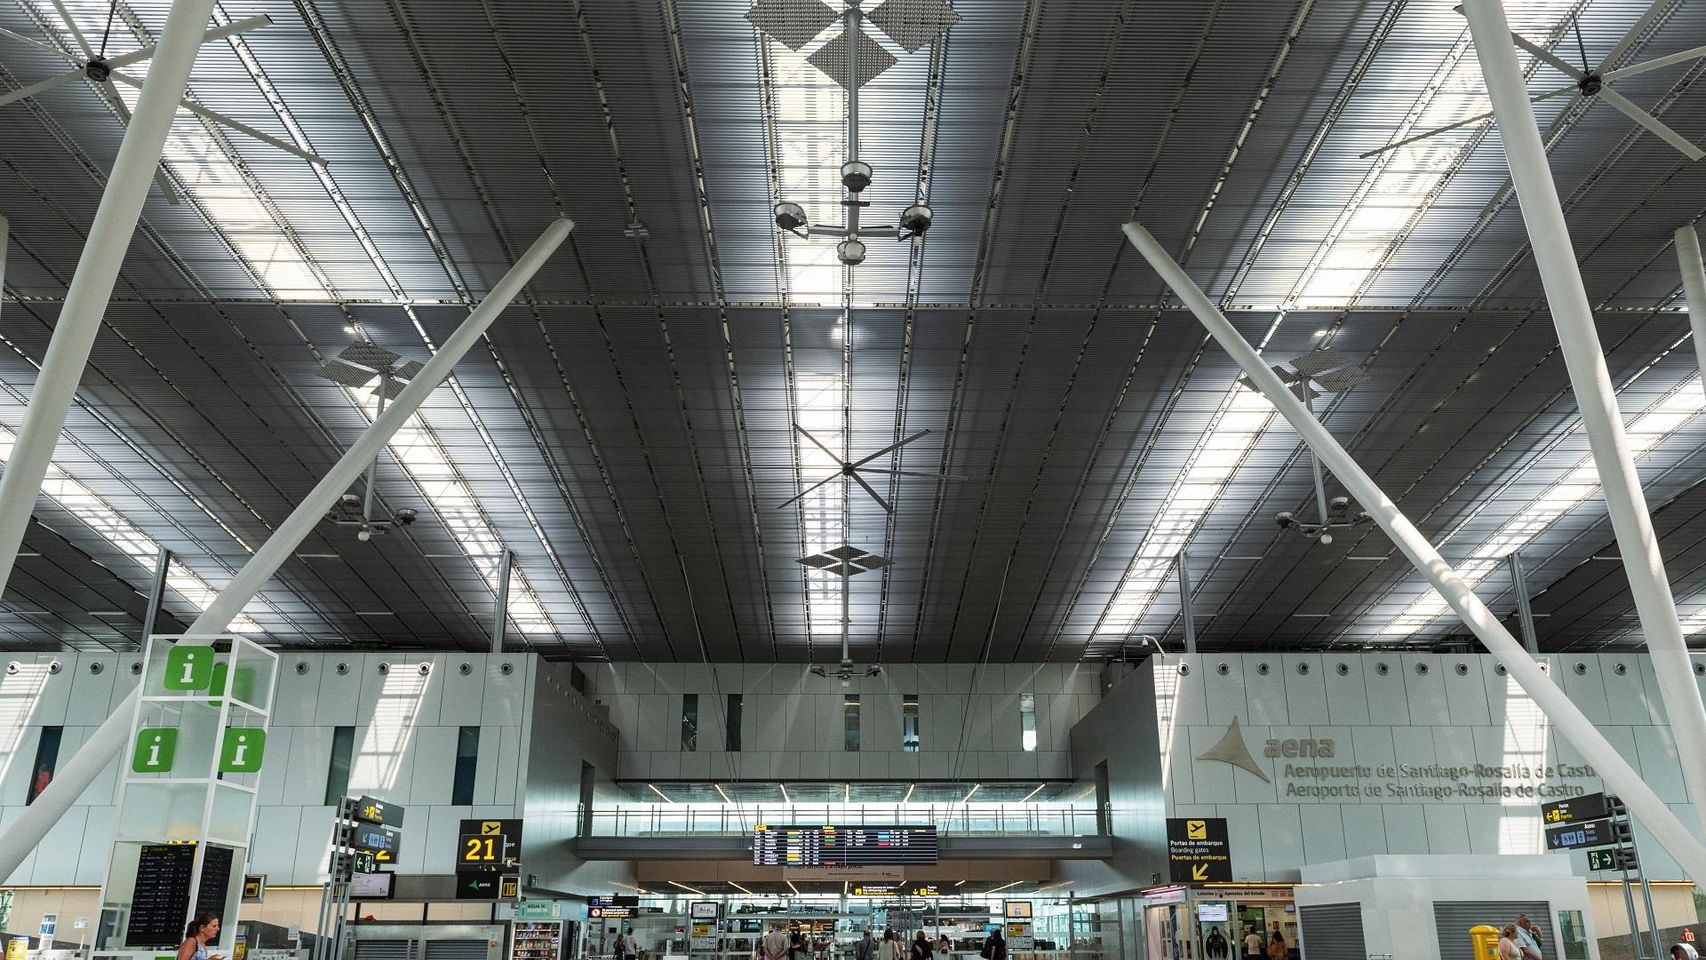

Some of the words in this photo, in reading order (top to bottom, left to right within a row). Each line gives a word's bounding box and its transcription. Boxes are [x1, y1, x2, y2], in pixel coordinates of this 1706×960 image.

[1264, 738, 1335, 758] aena
[1284, 764, 1371, 781] Aeropuerto
[1377, 763, 1396, 777] de
[1535, 764, 1554, 778] de
[1558, 764, 1596, 778] Castr
[1286, 783, 1358, 799] Aeroporto
[1364, 782, 1383, 796] de
[1515, 783, 1533, 798] de
[1537, 783, 1584, 798] Castro
[466, 839, 495, 860] 21
